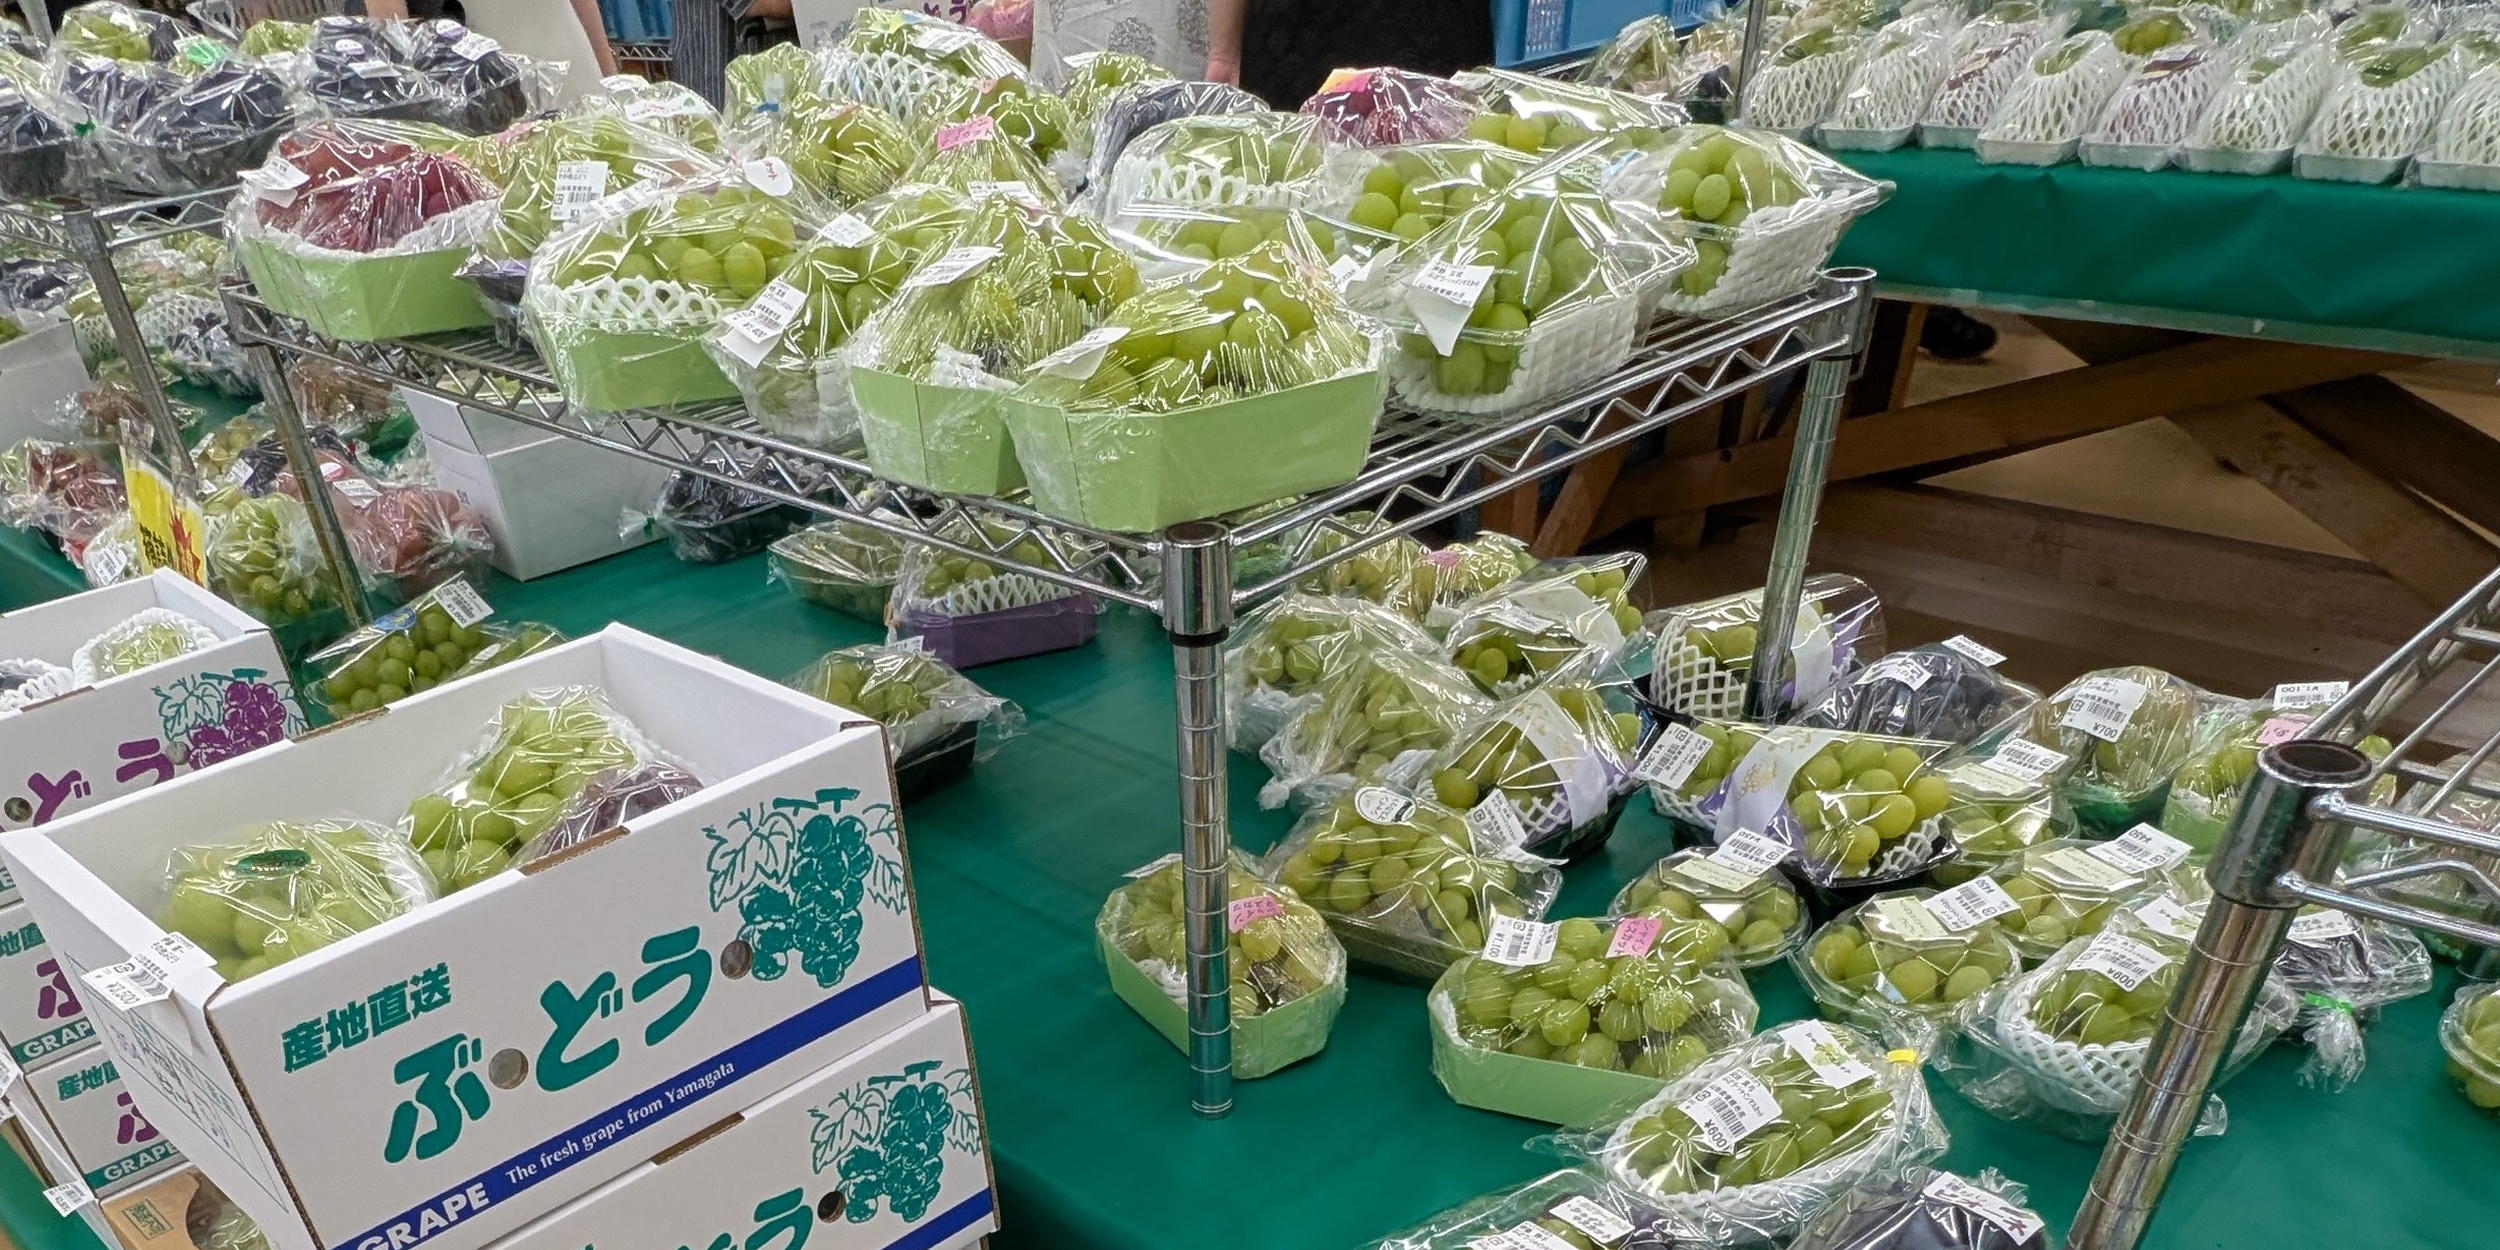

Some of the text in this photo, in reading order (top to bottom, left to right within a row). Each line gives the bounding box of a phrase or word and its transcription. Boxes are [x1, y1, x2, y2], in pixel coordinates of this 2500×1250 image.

[2093, 721, 2118, 739] ¥700
[0, 738, 175, 832] どう
[1738, 830, 1762, 844] ¥450
[2127, 828, 2152, 845] ¥450
[1974, 878, 1996, 895] ¥450
[2105, 966, 2137, 990] ¥600
[281, 962, 453, 1074] 産地直送
[22, 1020, 94, 1059] GRAP
[383, 925, 713, 1164] ぶどう
[506, 1060, 736, 1186] The fresh grape from Yamagata
[1701, 1116, 1729, 1149] ¥600
[1933, 1189, 2028, 1237] ピオーネ
